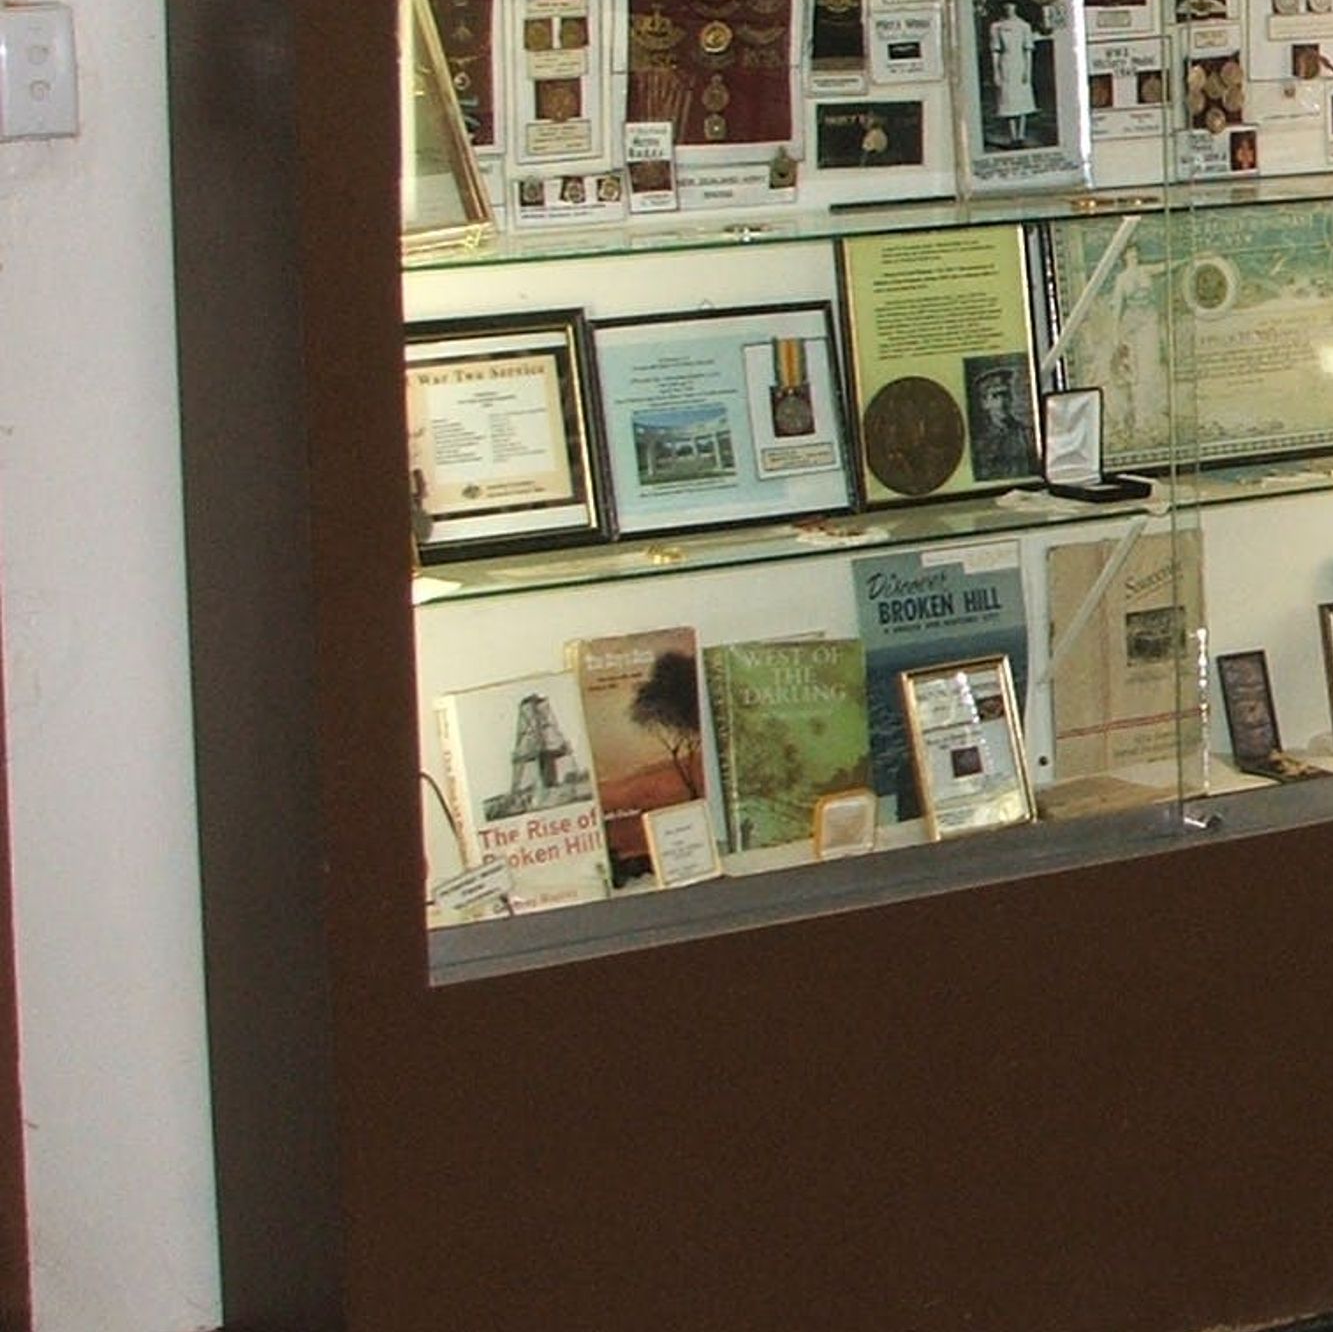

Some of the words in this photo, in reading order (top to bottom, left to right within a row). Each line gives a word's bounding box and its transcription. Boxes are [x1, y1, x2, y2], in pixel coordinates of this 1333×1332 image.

[418, 370, 448, 385] War
[453, 368, 484, 383] Two
[877, 593, 955, 626] BROKEN
[964, 586, 1003, 611] HILL
[478, 828, 520, 850] The
[526, 815, 571, 841] Rise
[578, 807, 598, 829] of
[565, 833, 601, 857] Hill
